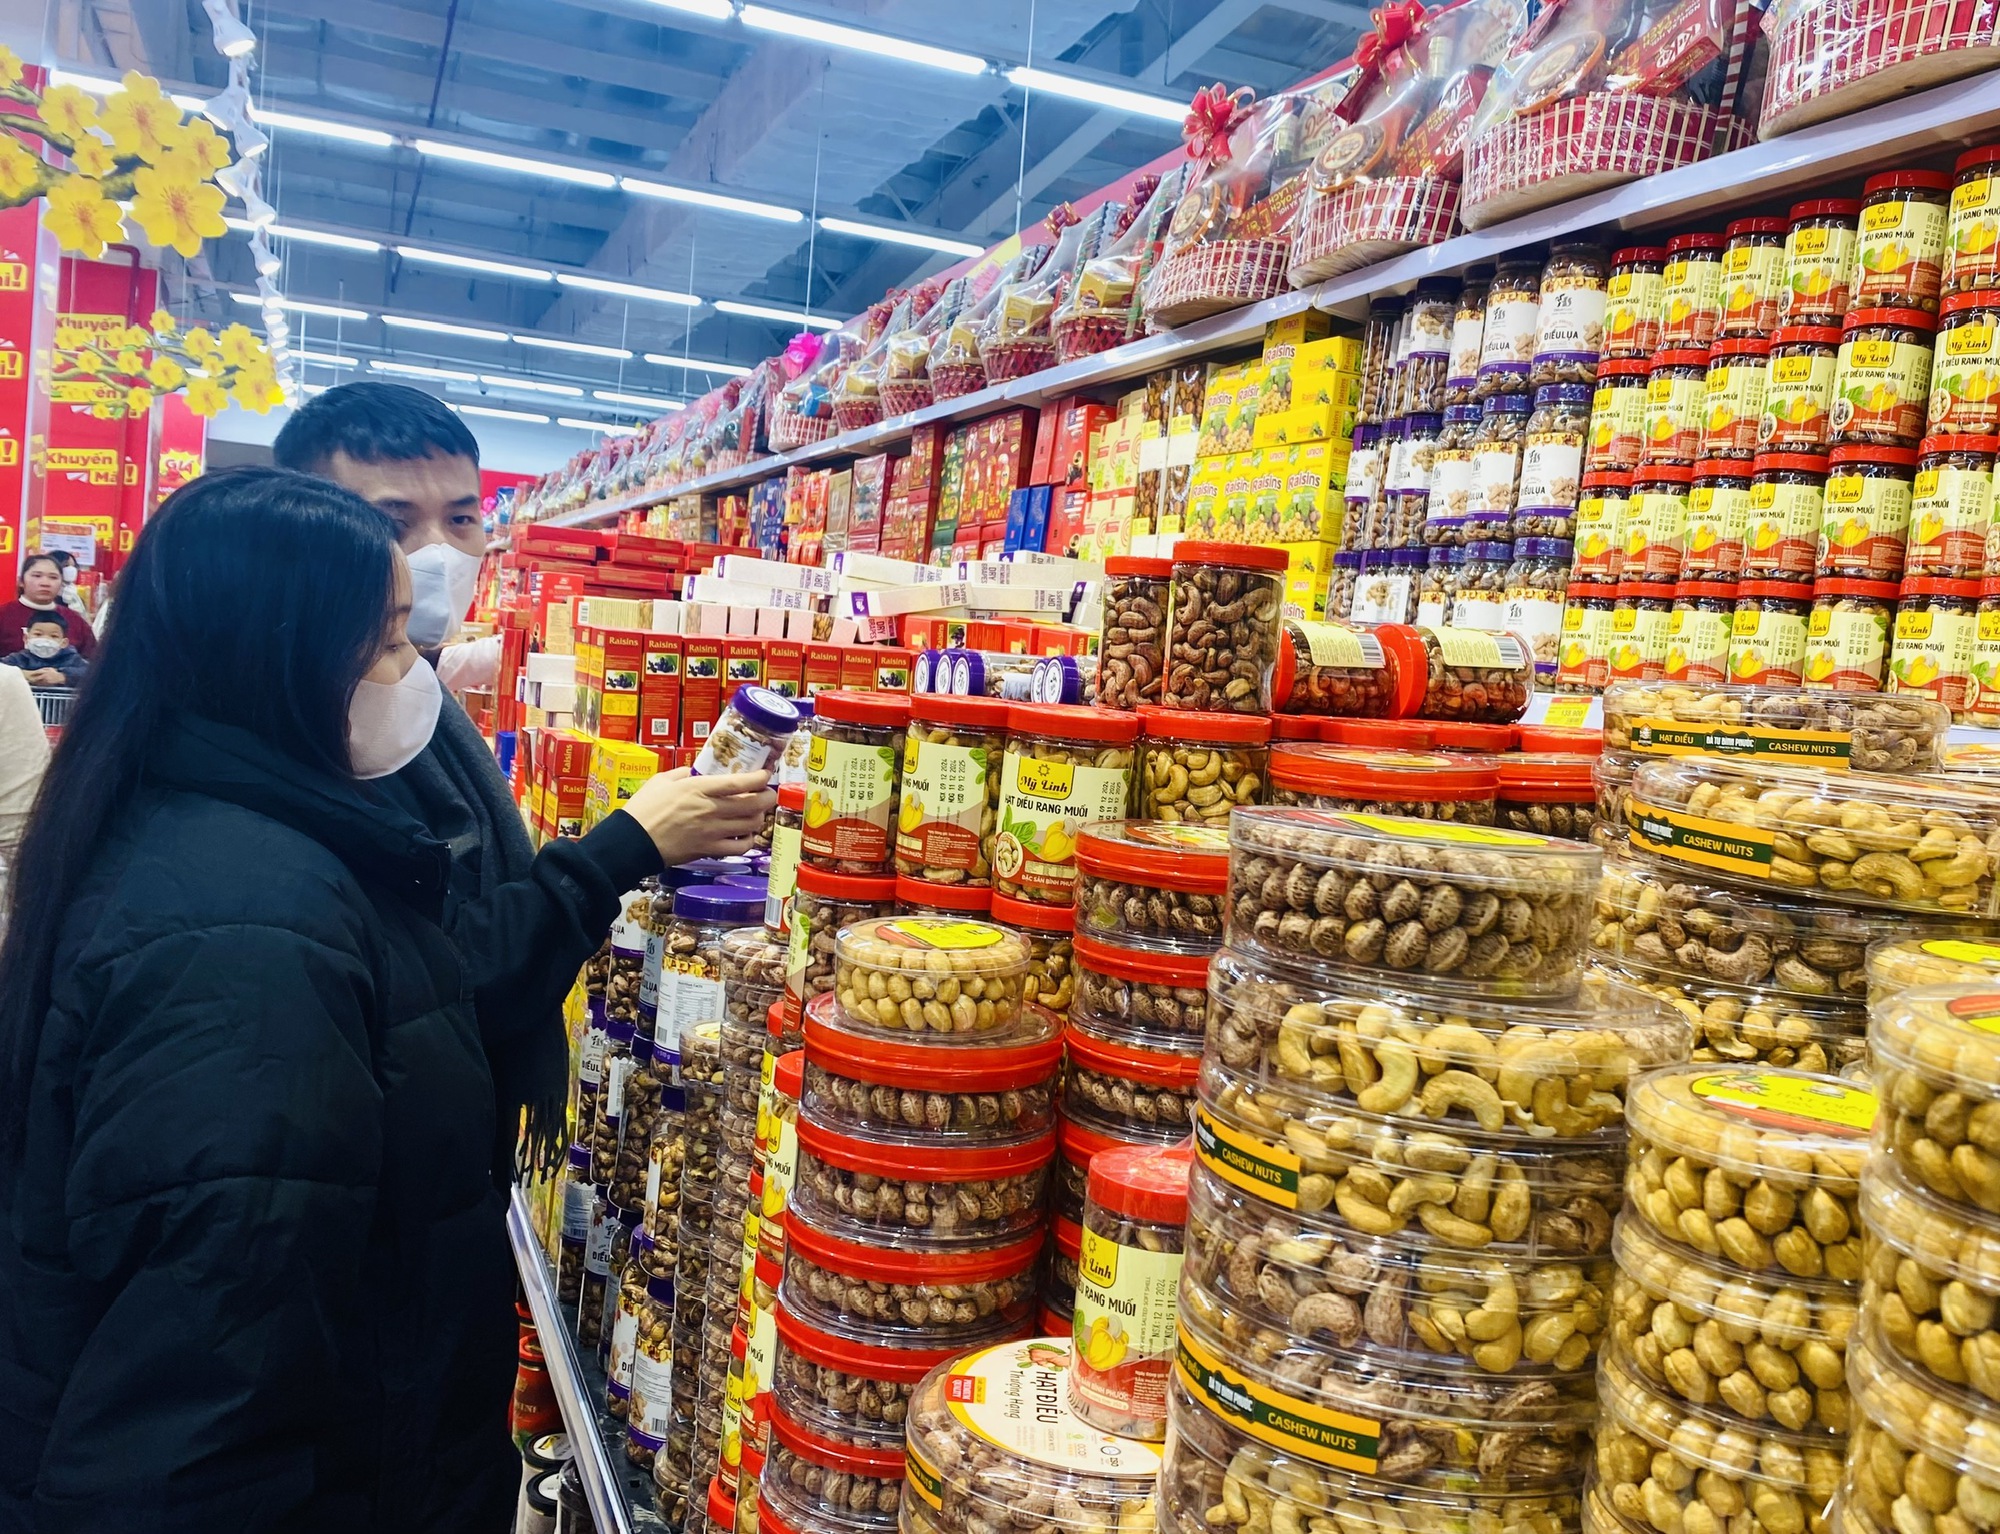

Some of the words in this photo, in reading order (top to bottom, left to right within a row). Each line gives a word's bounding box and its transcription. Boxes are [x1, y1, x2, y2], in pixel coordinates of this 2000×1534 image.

[1967, 192, 1986, 202] Linh
[1879, 215, 1898, 224] Linh
[1963, 210, 1982, 219] RANG
[1875, 231, 1894, 240] RANG
[1807, 241, 1824, 249] Linh
[1802, 256, 1820, 264] RANG
[1966, 339, 1988, 349] Linh
[1265, 344, 1295, 364] Raisins
[1344, 344, 1352, 370] Raisins
[1868, 353, 1890, 363] Linh
[1788, 369, 1808, 377] Linh
[1865, 370, 1885, 378] RANG
[1338, 378, 1347, 404] Raisins
[1784, 384, 1803, 392] RANG
[1207, 391, 1232, 408] Raisins
[46, 452, 113, 466] Khuyến
[1252, 475, 1282, 493] Raisins
[1287, 472, 1321, 491] Raisins
[1192, 483, 1218, 498] Raisins
[1931, 499, 1950, 508] MUỐI
[1769, 511, 1785, 519] MUỐI
[1837, 506, 1854, 514] RANG
[1856, 505, 1875, 514] MUỐI
[1637, 518, 1651, 526] MUỐI
[1707, 513, 1722, 521] MUỐI
[1598, 521, 1612, 530] MUỐI
[980, 563, 988, 584] GRAPES
[988, 566, 996, 581] DRY
[814, 573, 823, 588] DRY
[823, 571, 832, 592] GRAPES
[952, 586, 960, 602] DRY
[785, 593, 794, 608] DRY
[1048, 594, 1056, 607] DRY
[868, 618, 877, 639] GRAPES
[876, 620, 885, 635] DRY
[1910, 625, 1928, 634] Linh
[609, 636, 639, 646] Raisins
[1577, 632, 1591, 640] MUỐI
[1630, 633, 1645, 642] MUỐI
[649, 640, 677, 649] Raisins
[1753, 638, 1769, 646] MUỐI
[1824, 639, 1840, 648] MUỐI
[1905, 642, 1923, 650] RANG
[1925, 643, 1945, 651] MUỐI
[689, 643, 717, 655] Raisins
[730, 646, 758, 657] Raisins
[771, 647, 799, 658] Raisins
[811, 652, 837, 662] Raisins
[845, 655, 872, 664] Raisins
[881, 657, 907, 666] Raisins
[1659, 733, 1673, 745] HẠT
[1674, 733, 1694, 744] ĐIỀU
[1768, 742, 1809, 753] CASHEW
[1811, 744, 1836, 754] NUTS
[562, 744, 572, 773] Raisins
[619, 762, 651, 772] Raisins
[820, 774, 838, 789] MUỐI
[912, 776, 929, 792] MUỐI
[1020, 776, 1037, 790] Mỹ
[1041, 780, 1068, 793] Linh
[1036, 802, 1060, 814] RANG
[1064, 804, 1088, 817] MUỐI
[1682, 834, 1723, 852] CASHEW
[1724, 840, 1754, 858] NUTS
[774, 1160, 791, 1176] MUỐI
[1222, 1147, 1253, 1173] CASHEW
[1255, 1164, 1282, 1183] NUTS
[1089, 1257, 1112, 1280] Linh
[1156, 1279, 1165, 1295] 2024
[1085, 1285, 1105, 1307] RANG
[1109, 1297, 1137, 1316] MUỐI
[1155, 1299, 1163, 1307] 11
[1168, 1300, 1176, 1308] 11
[1154, 1311, 1162, 1319] 12
[1004, 1370, 1023, 1396] Thượng
[729, 1393, 742, 1407] Linh
[1004, 1399, 1022, 1419] Hạng
[1268, 1412, 1319, 1440] CASHEW
[1320, 1431, 1357, 1451] NUTS
